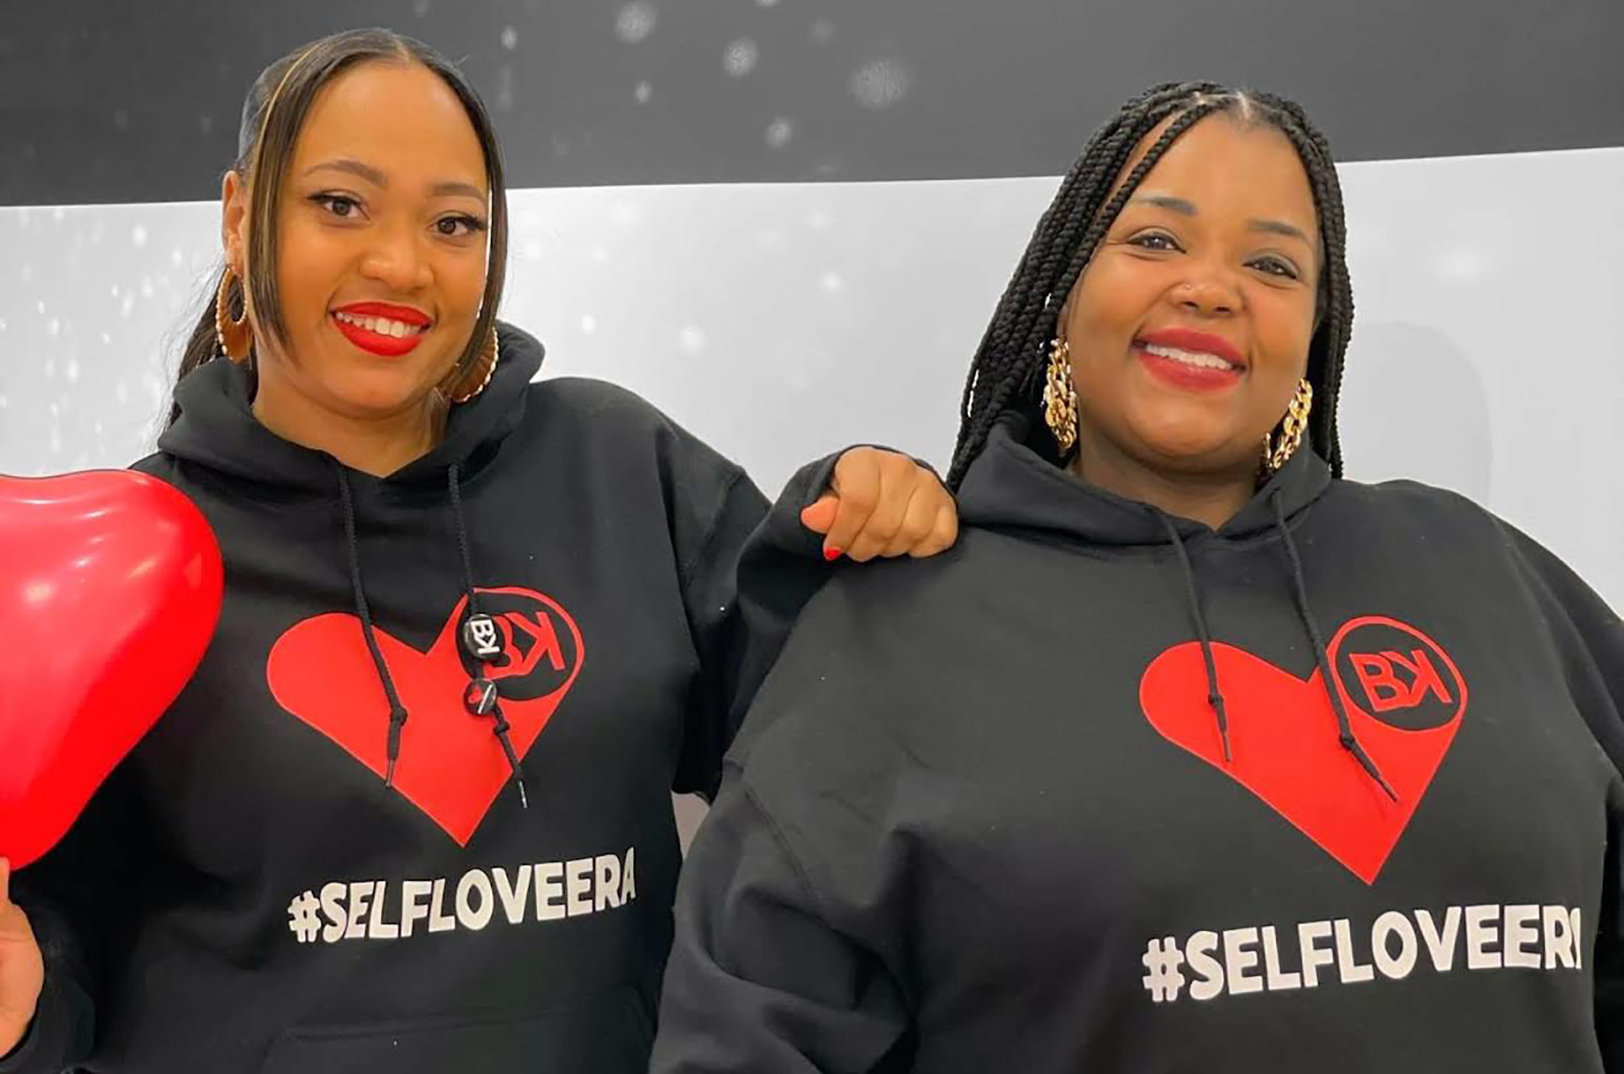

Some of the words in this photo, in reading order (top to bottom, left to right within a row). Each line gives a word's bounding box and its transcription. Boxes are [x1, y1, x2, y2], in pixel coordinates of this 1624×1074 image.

[470, 619, 500, 654] BK
[1349, 650, 1452, 712] BK
[287, 847, 636, 943] #SELFLOVEERA
